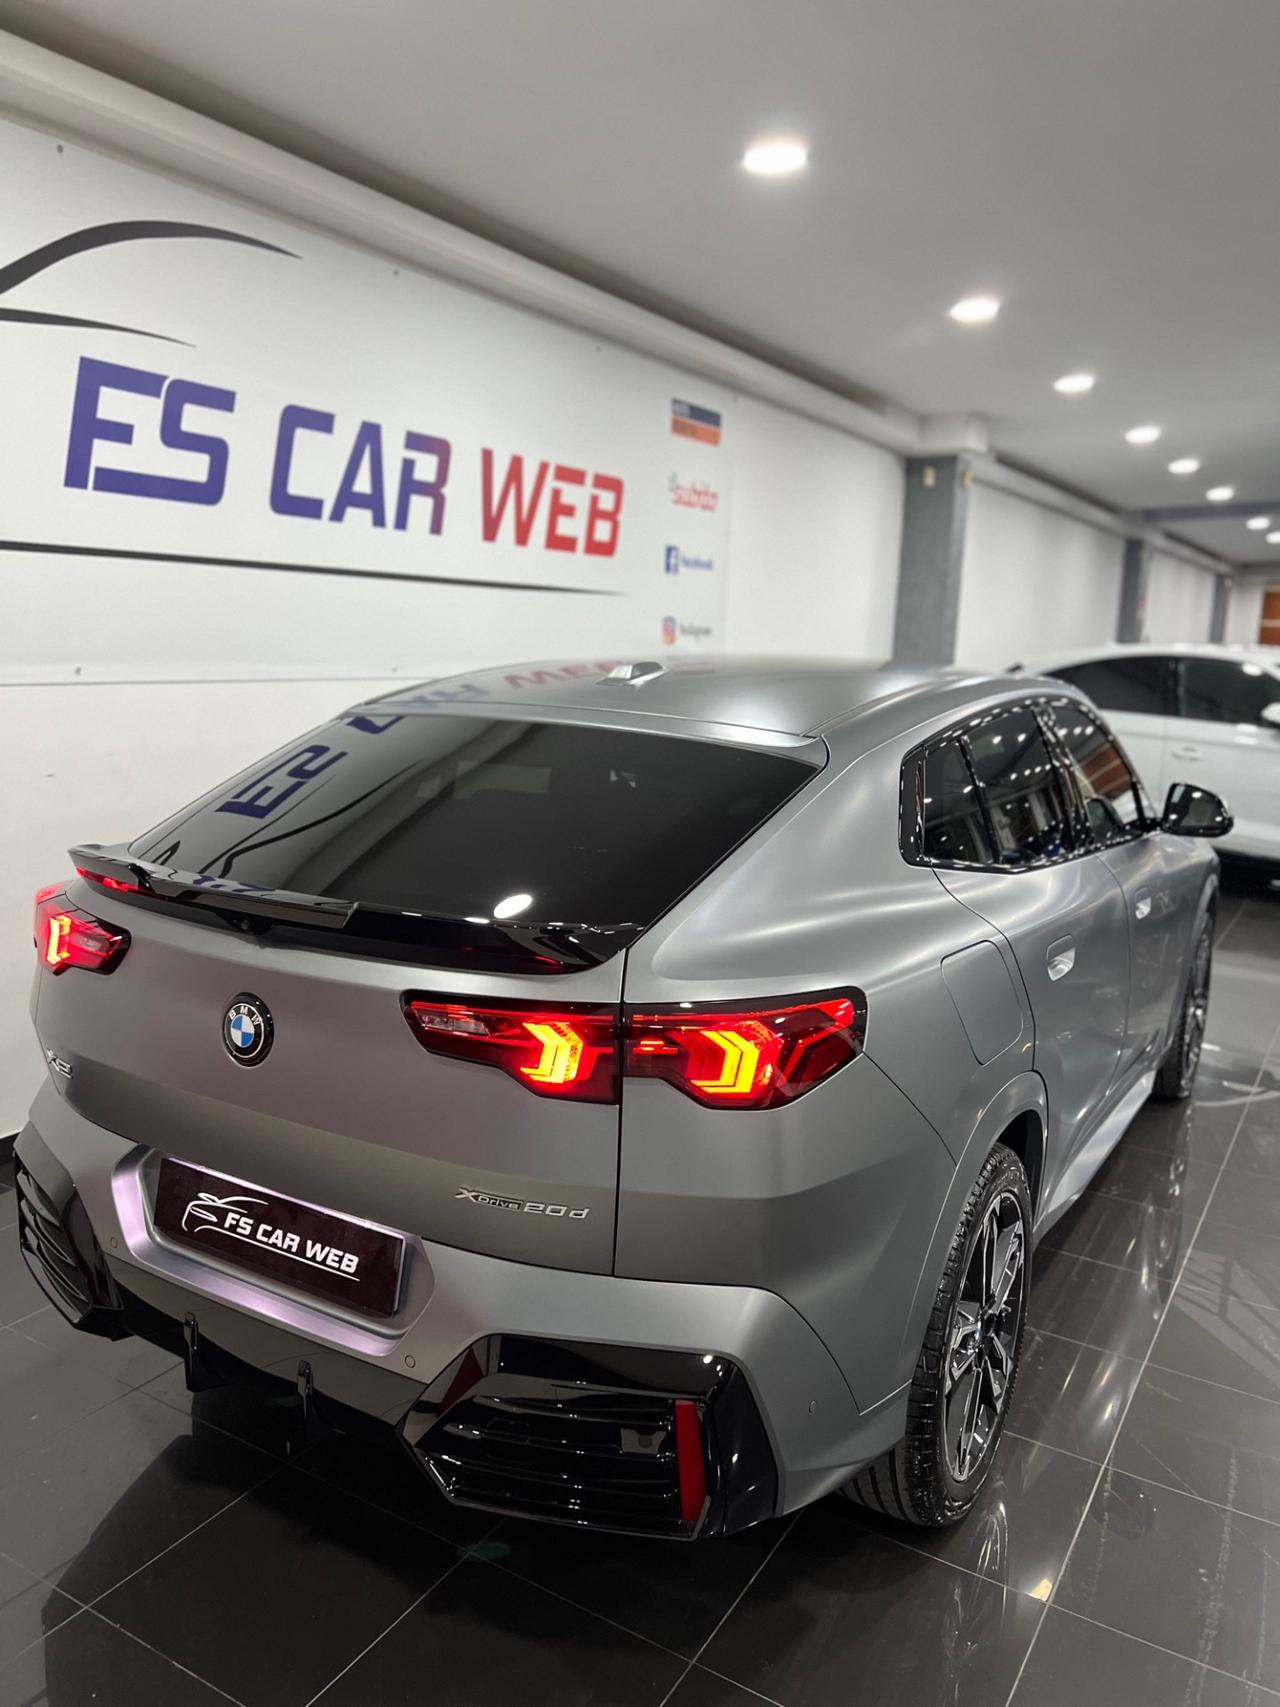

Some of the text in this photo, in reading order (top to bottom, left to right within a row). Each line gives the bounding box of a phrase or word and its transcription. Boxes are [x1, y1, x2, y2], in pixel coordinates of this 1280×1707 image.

[269, 404, 452, 536] CAR
[481, 447, 625, 558] WEB
[229, 1005, 261, 1026] BMW
[223, 1211, 359, 1274] FS CAR WEB
